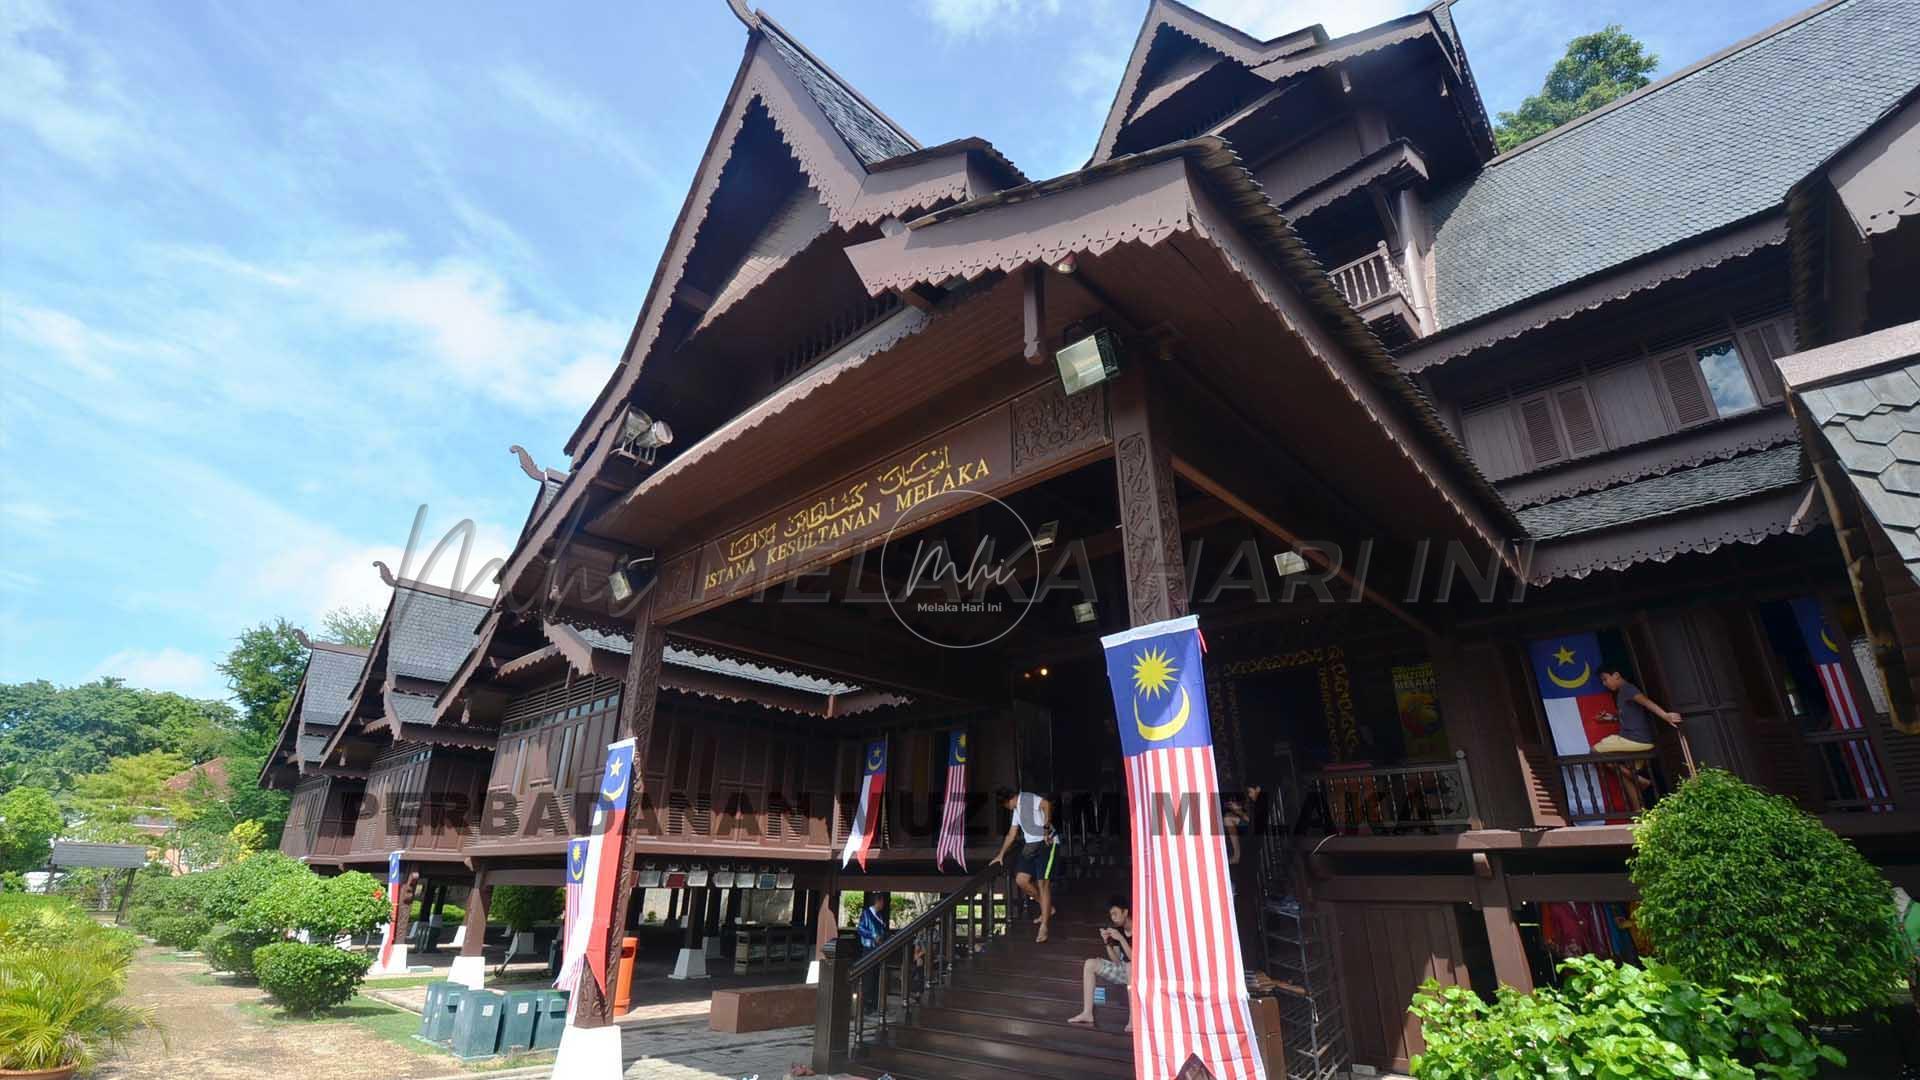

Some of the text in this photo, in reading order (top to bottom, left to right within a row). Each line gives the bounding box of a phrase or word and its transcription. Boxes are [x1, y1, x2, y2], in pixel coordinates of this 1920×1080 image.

[703, 458, 990, 591] ISTANA KESULTANAN MELAKA
